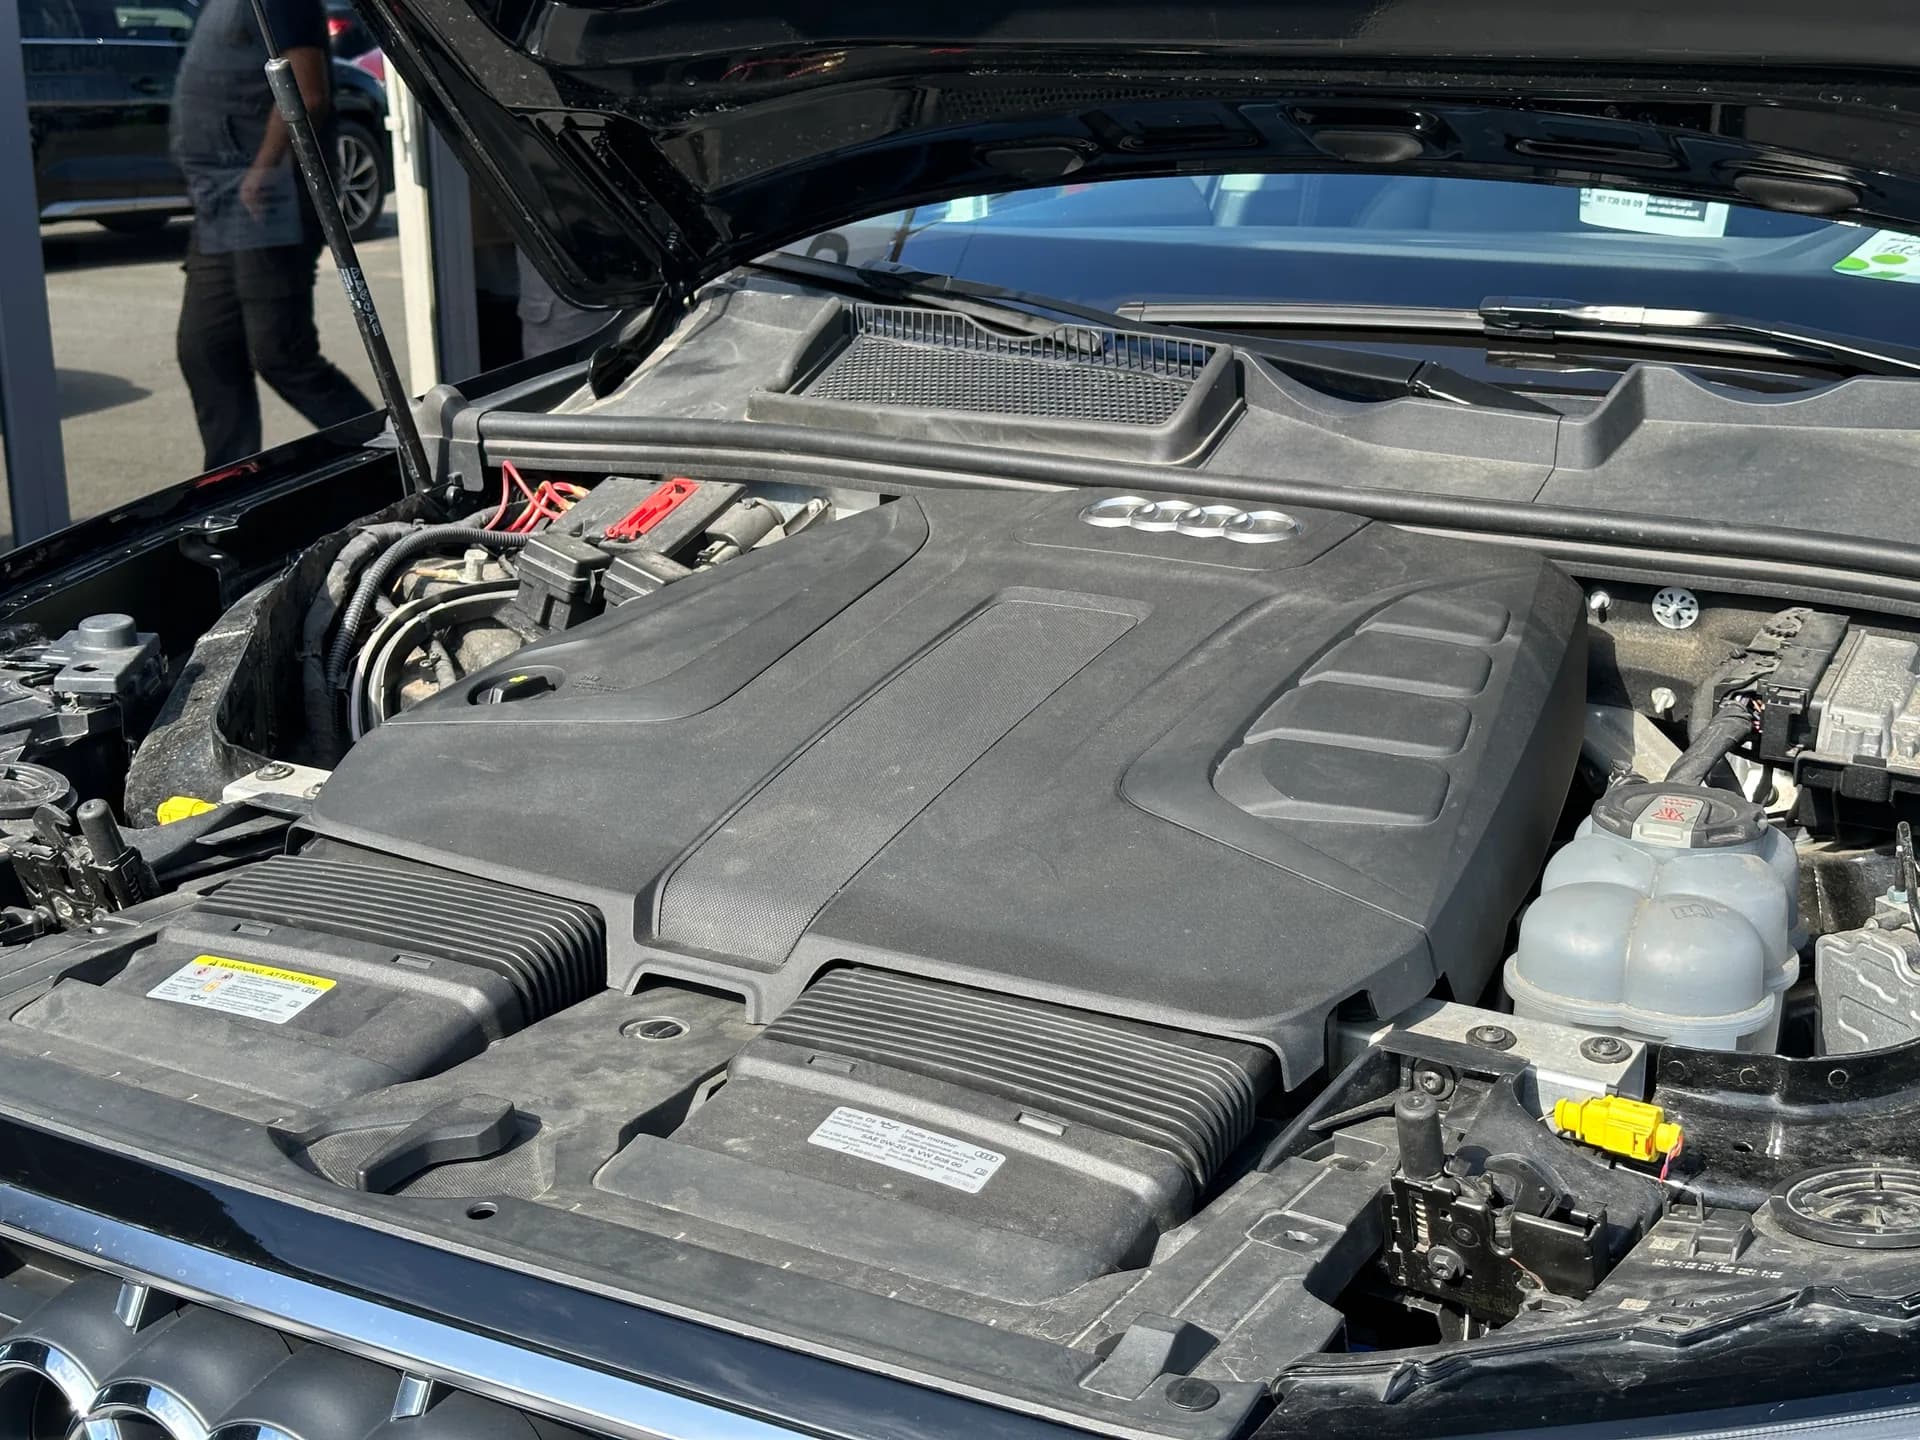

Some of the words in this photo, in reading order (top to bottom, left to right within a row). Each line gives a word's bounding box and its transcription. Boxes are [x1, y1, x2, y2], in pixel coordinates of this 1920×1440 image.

[219, 961, 265, 975] WARNING
[266, 971, 319, 985] ATTENTION
[860, 1133, 880, 1142] SAE
[917, 1149, 934, 1158] VW
[927, 1136, 959, 1148] moteur
